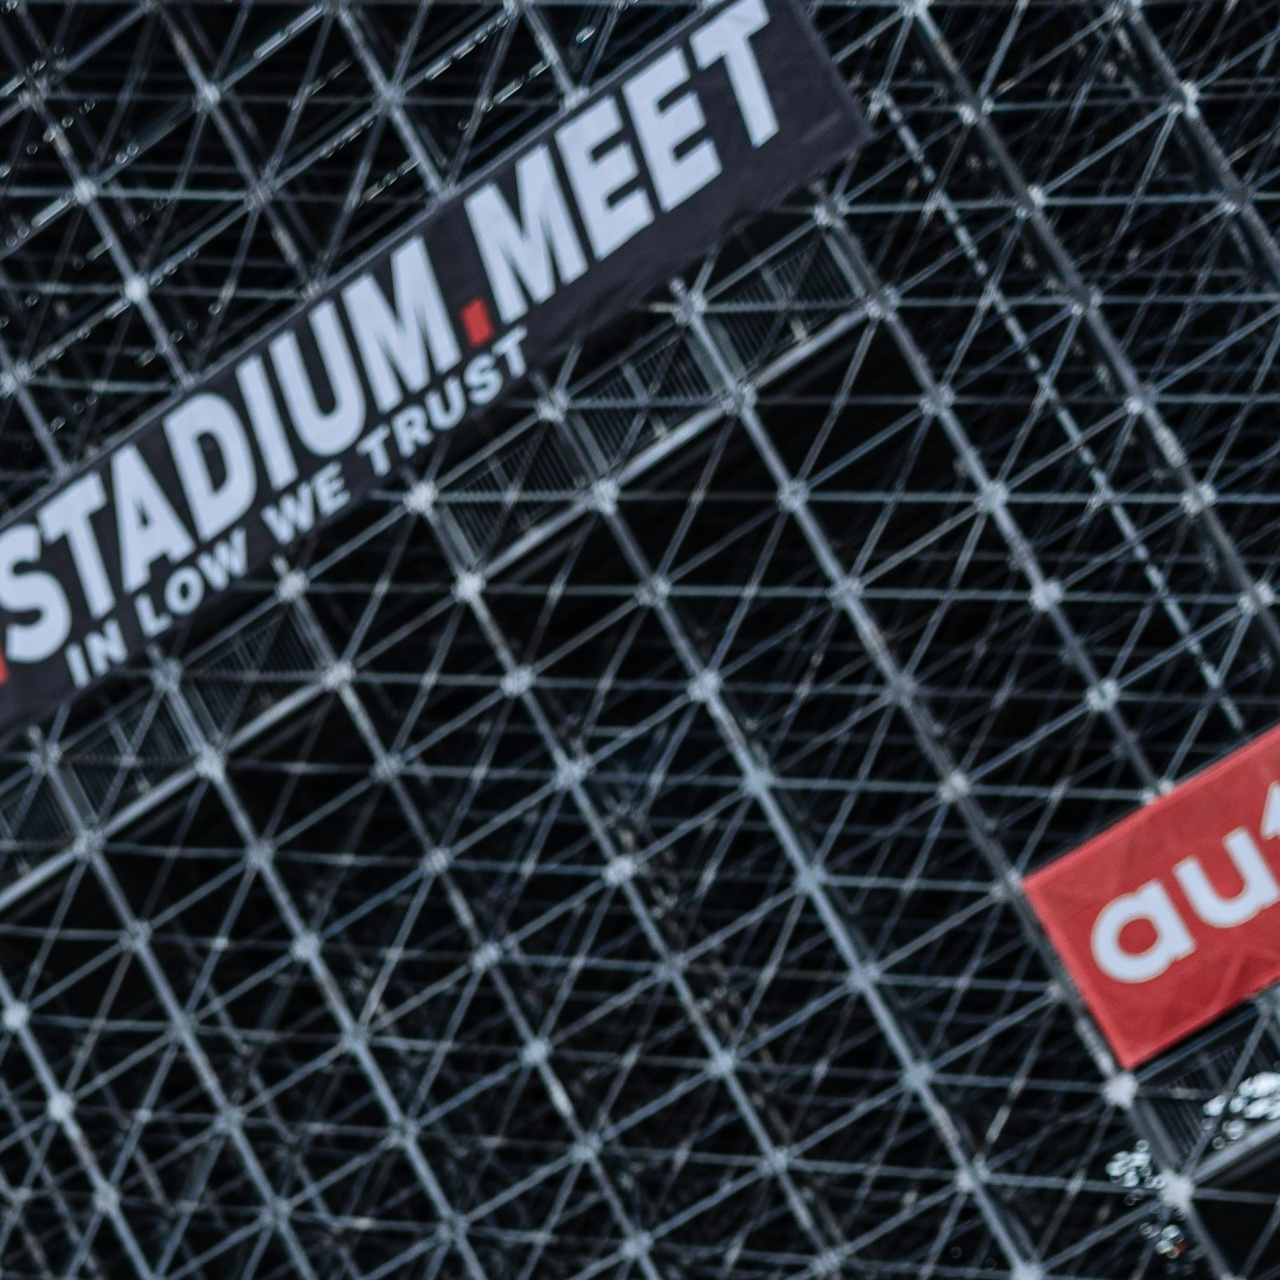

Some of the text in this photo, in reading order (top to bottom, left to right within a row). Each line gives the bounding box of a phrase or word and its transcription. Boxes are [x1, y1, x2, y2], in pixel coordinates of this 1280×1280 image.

[65, 326, 528, 688] IN LOW WE TRUST
[1090, 780, 1280, 984] au
